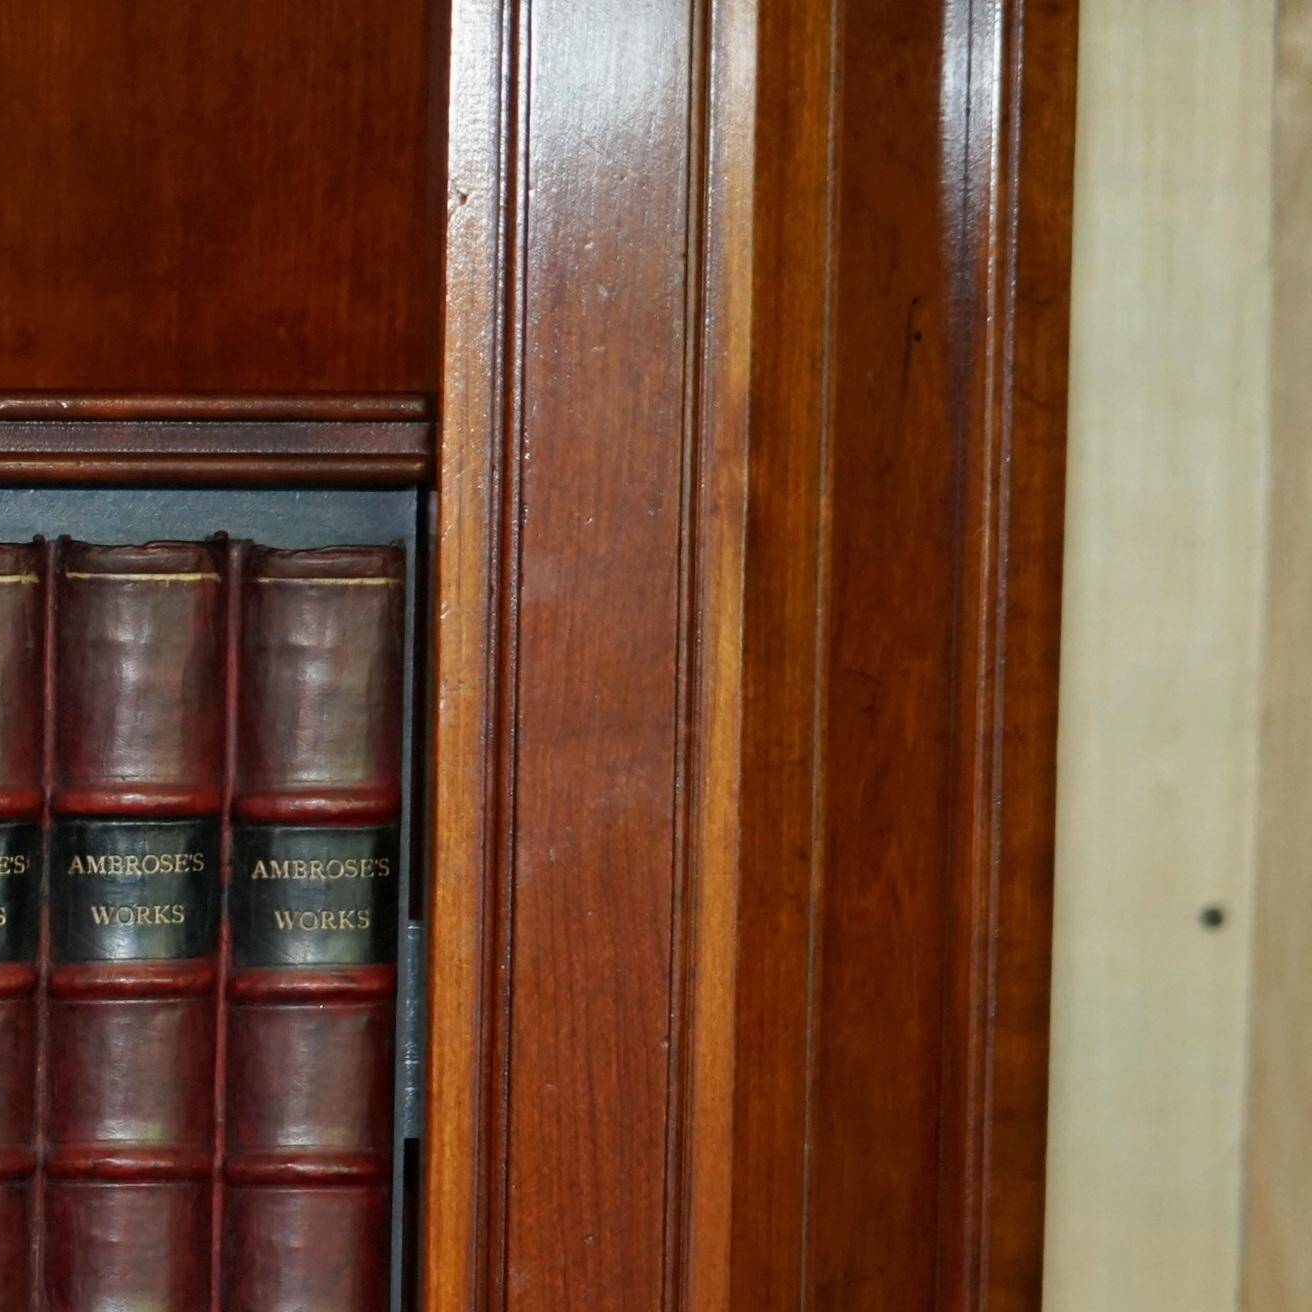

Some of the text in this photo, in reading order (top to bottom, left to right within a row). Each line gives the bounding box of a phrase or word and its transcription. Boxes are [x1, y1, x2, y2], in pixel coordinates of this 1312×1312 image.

[67, 852, 206, 876] AMBROSE'S
[251, 857, 391, 880] AMBROSE'S
[90, 903, 186, 927] WORKS
[274, 908, 371, 932] WORKS
